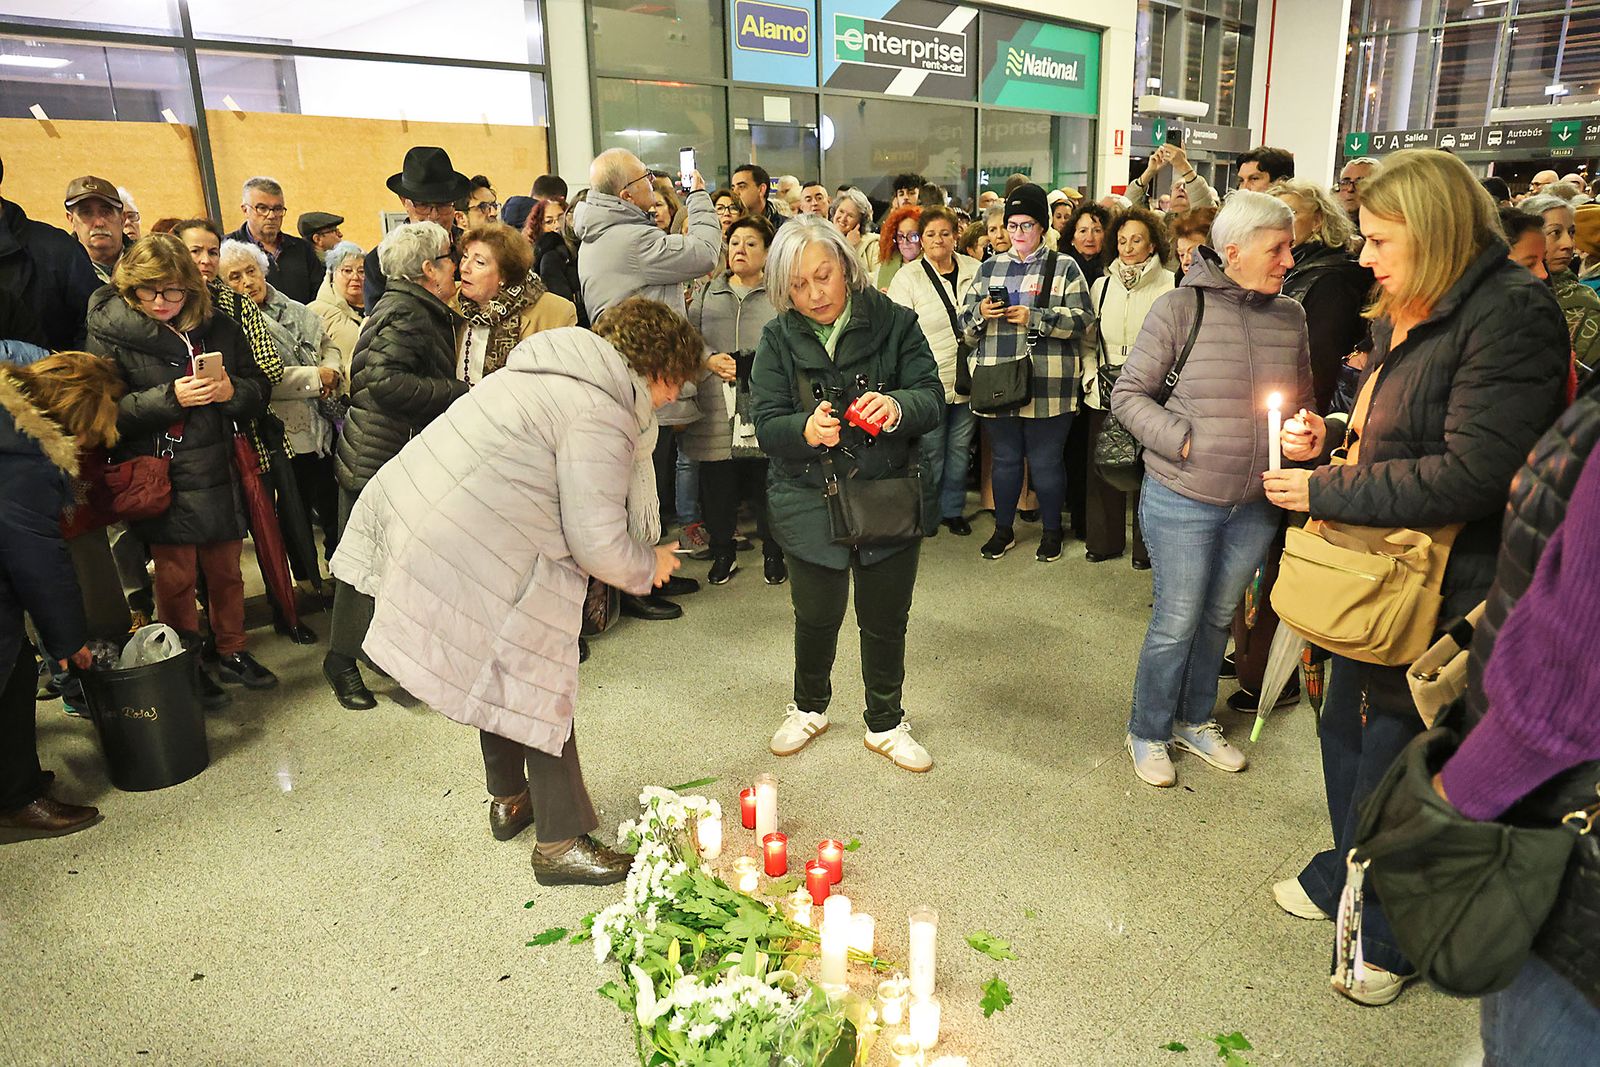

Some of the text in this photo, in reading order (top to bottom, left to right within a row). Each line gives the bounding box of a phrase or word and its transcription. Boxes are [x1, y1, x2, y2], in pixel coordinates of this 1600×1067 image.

[741, 15, 808, 44] Alamo
[843, 28, 964, 64] enterprise
[921, 59, 964, 74] rent-a-car
[1022, 52, 1077, 81] National
[1389, 132, 1429, 149] A Salida
[1460, 131, 1477, 141] Taxi
[1507, 127, 1543, 138] Autobús
